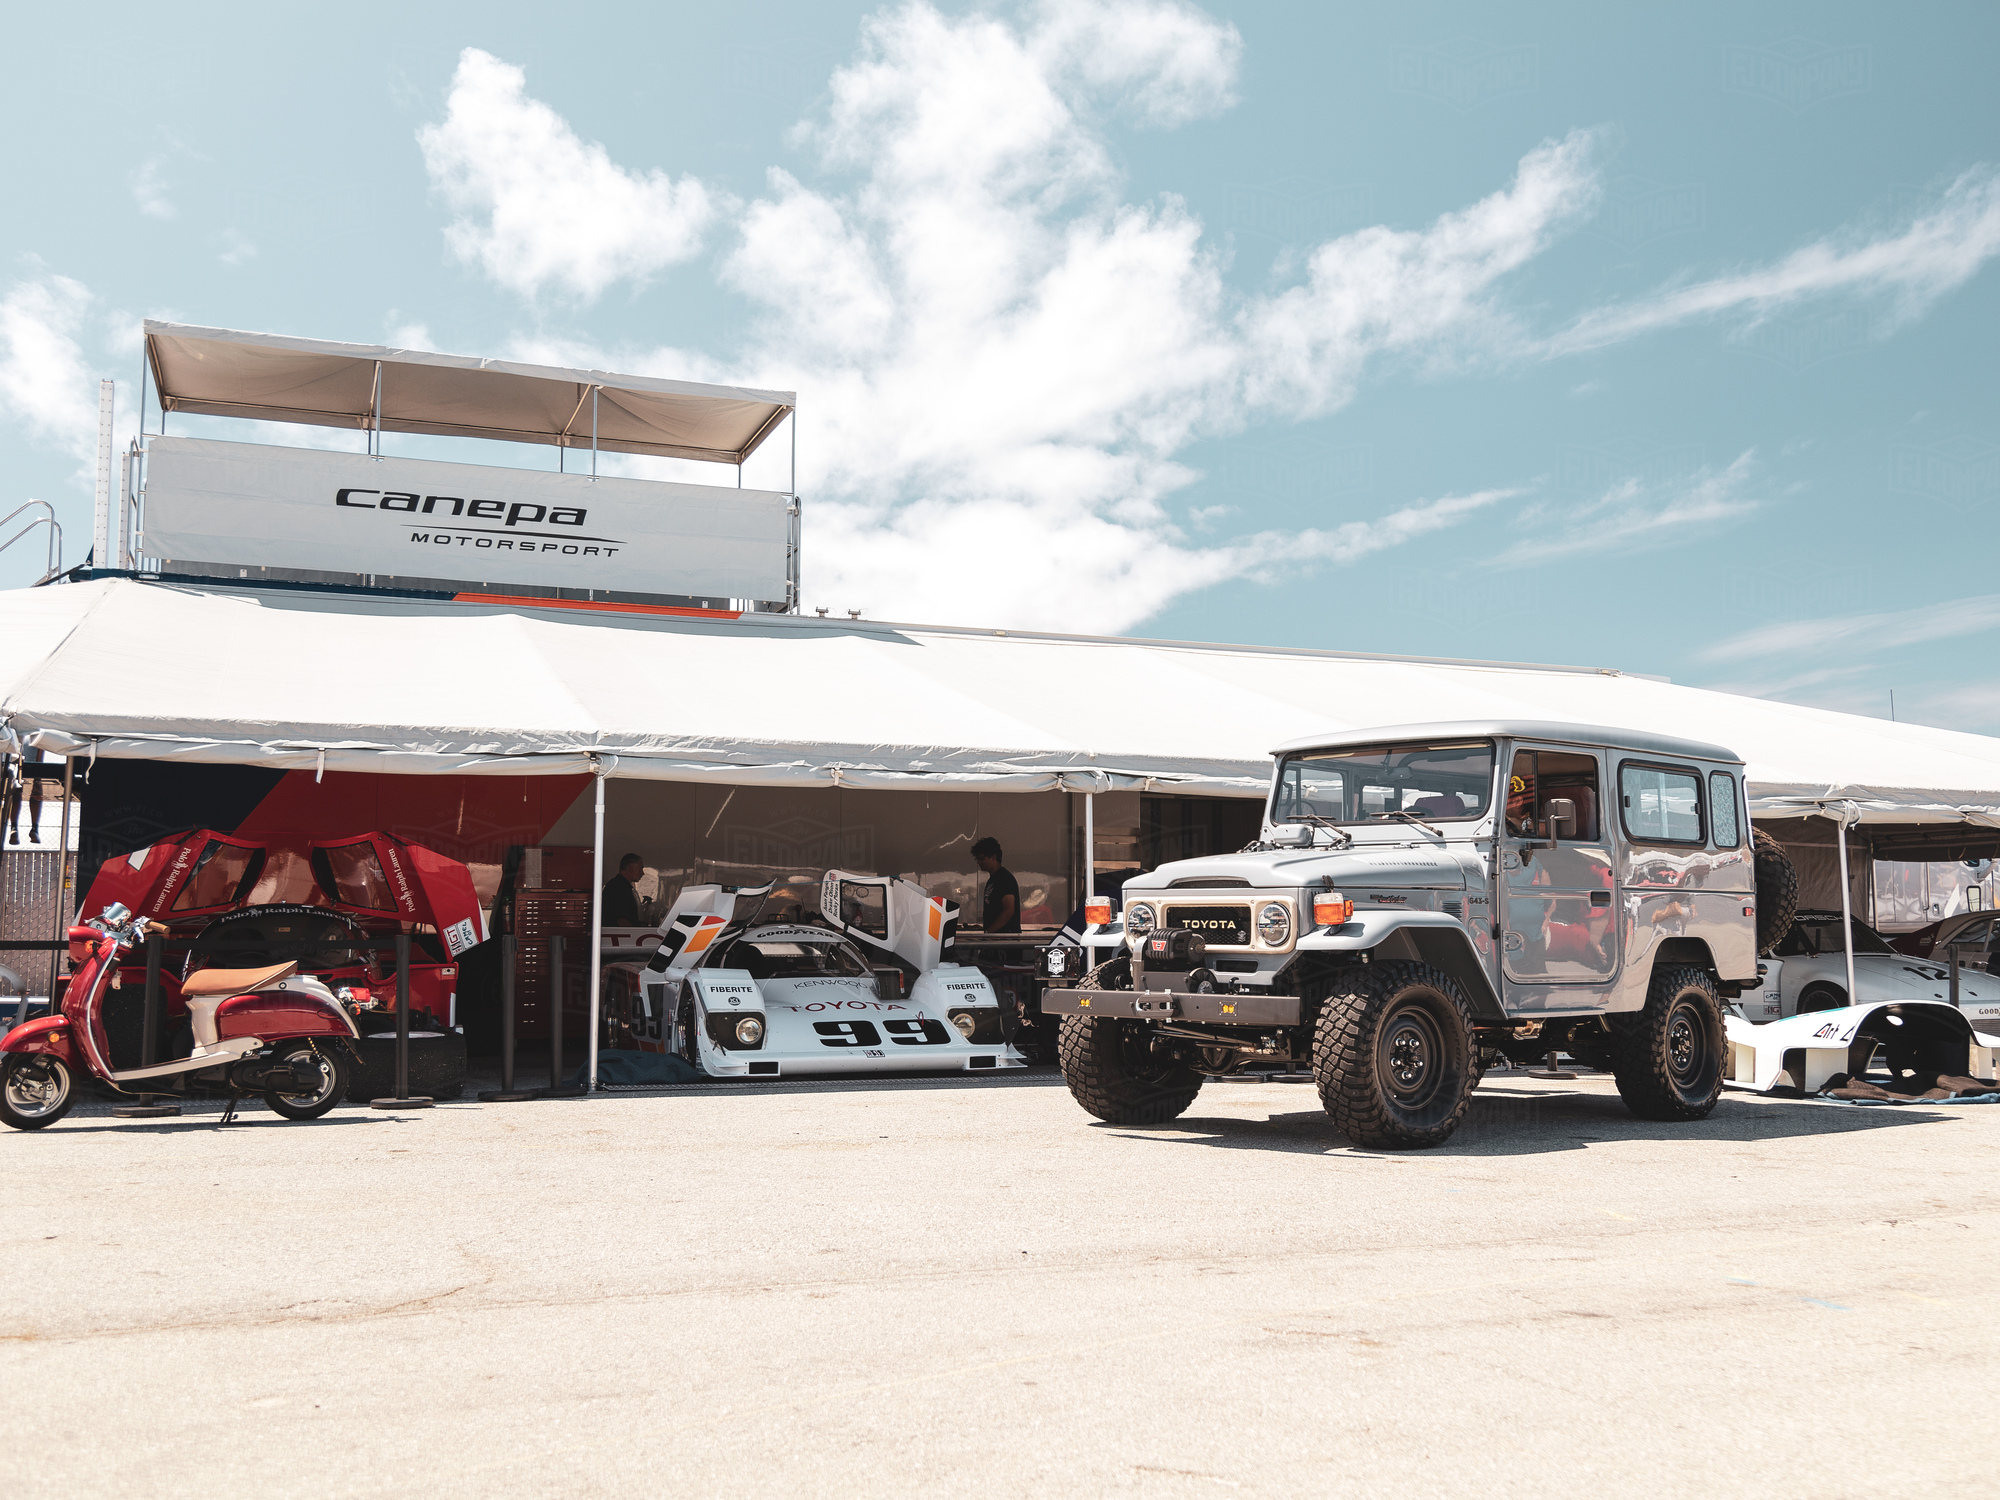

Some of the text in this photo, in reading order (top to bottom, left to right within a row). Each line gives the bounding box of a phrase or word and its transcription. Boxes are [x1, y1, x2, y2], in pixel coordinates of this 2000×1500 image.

[336, 487, 588, 527] canepa
[410, 532, 620, 557] MOTORSPORT
[152, 847, 192, 913] Polo Ralph Lauren
[388, 848, 416, 912] Polo Ralph Lauren
[221, 911, 249, 923] Polo
[1182, 919, 1236, 929] TOYOTA
[757, 929, 834, 939] GOODYEAR
[1903, 966, 1961, 981] 12
[794, 980, 868, 989] KENWOOD
[946, 982, 987, 991] FIBERITE
[783, 1001, 907, 1013] TOYOTA
[813, 1020, 951, 1047] 99
[1813, 1023, 1841, 1040] Art
